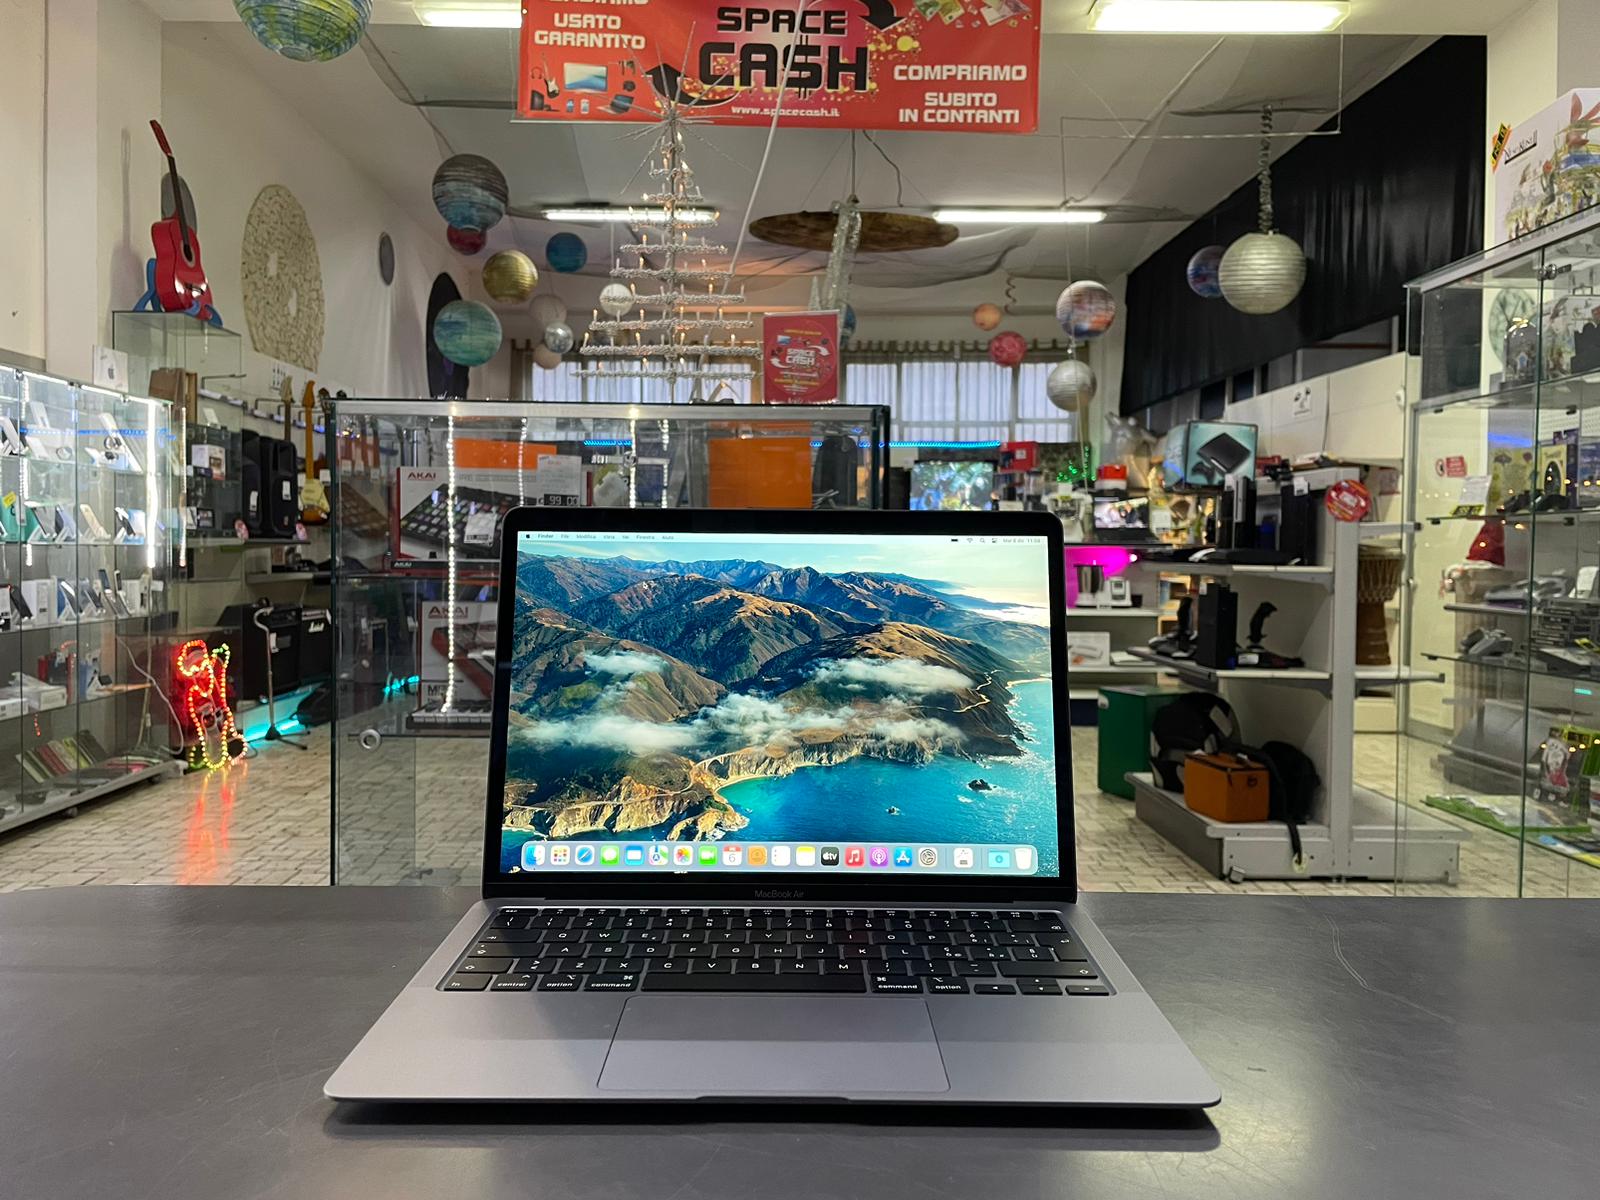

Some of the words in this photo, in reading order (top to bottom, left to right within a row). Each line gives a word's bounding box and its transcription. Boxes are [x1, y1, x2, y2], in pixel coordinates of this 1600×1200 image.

[553, 12, 622, 30] USATO
[717, 7, 847, 36] SPACE
[534, 30, 646, 50] GARANTITO
[893, 64, 1028, 82] COMPRIAMO
[924, 92, 998, 108] SUBITO
[898, 108, 919, 123] IN
[923, 109, 1020, 124] CONTANTI
[407, 471, 437, 481] AKAI
[728, 853, 736, 863] 6
[754, 890, 792, 898] MacBook
